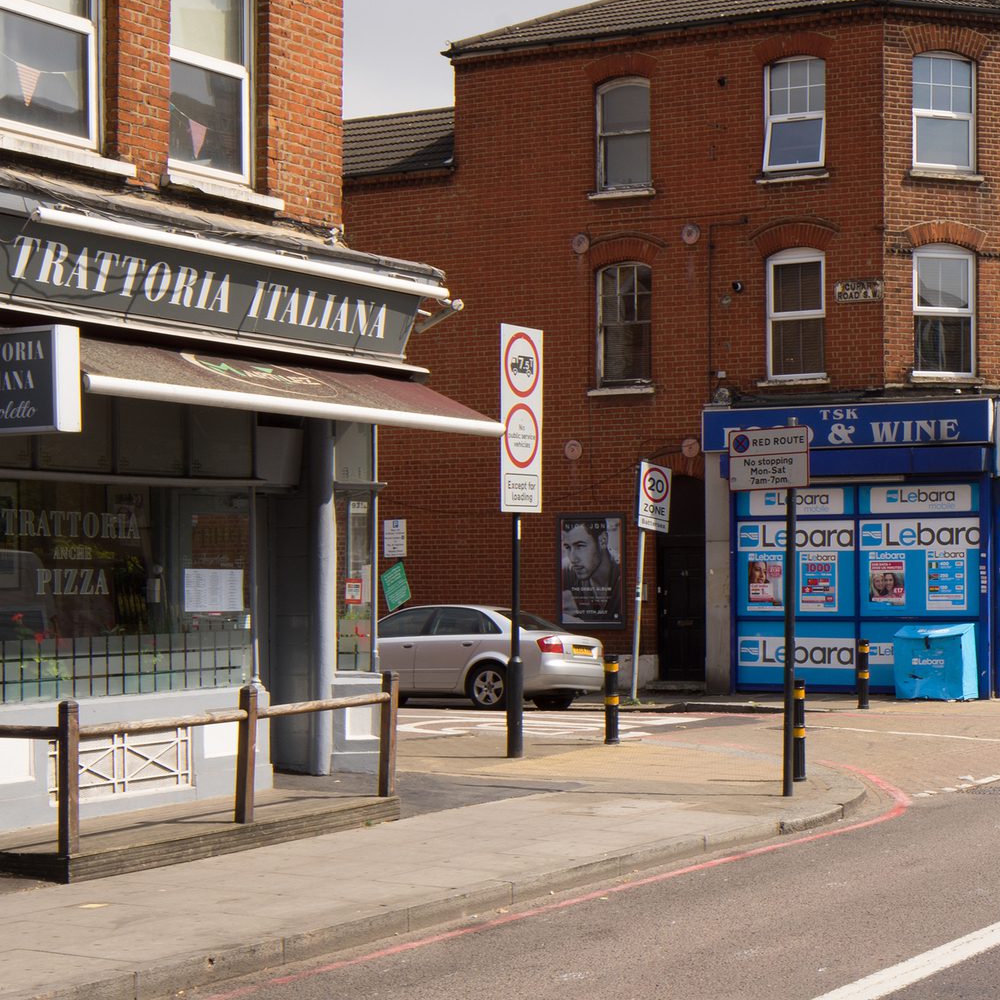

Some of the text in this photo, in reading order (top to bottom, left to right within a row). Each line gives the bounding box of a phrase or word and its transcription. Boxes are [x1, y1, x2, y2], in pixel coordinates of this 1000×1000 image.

[12, 235, 387, 338] TRATTORIA ITALIANA
[838, 292, 860, 300] ROAD
[820, 408, 858, 420] TSK
[828, 423, 855, 445] &
[869, 418, 960, 443] WINE
[752, 435, 805, 446] RED ROUTE
[743, 457, 793, 466] No stopping
[750, 466, 786, 475] Mon-Sat
[508, 480, 536, 490] Except for
[647, 477, 665, 494] 20
[750, 476, 788, 485] 7am-7pm
[512, 493, 533, 503] loading
[900, 488, 955, 503] Lebara
[643, 503, 666, 517] ZONE
[803, 505, 830, 513] mobile
[928, 502, 956, 510] mobile
[1, 508, 140, 539] TRATTORIA
[53, 546, 93, 560] ANCHE
[755, 553, 783, 561] Lebara
[876, 551, 906, 560] Lebara
[935, 550, 965, 559] Lebara
[806, 563, 832, 573] 1000
[35, 568, 109, 595] PIZZA
